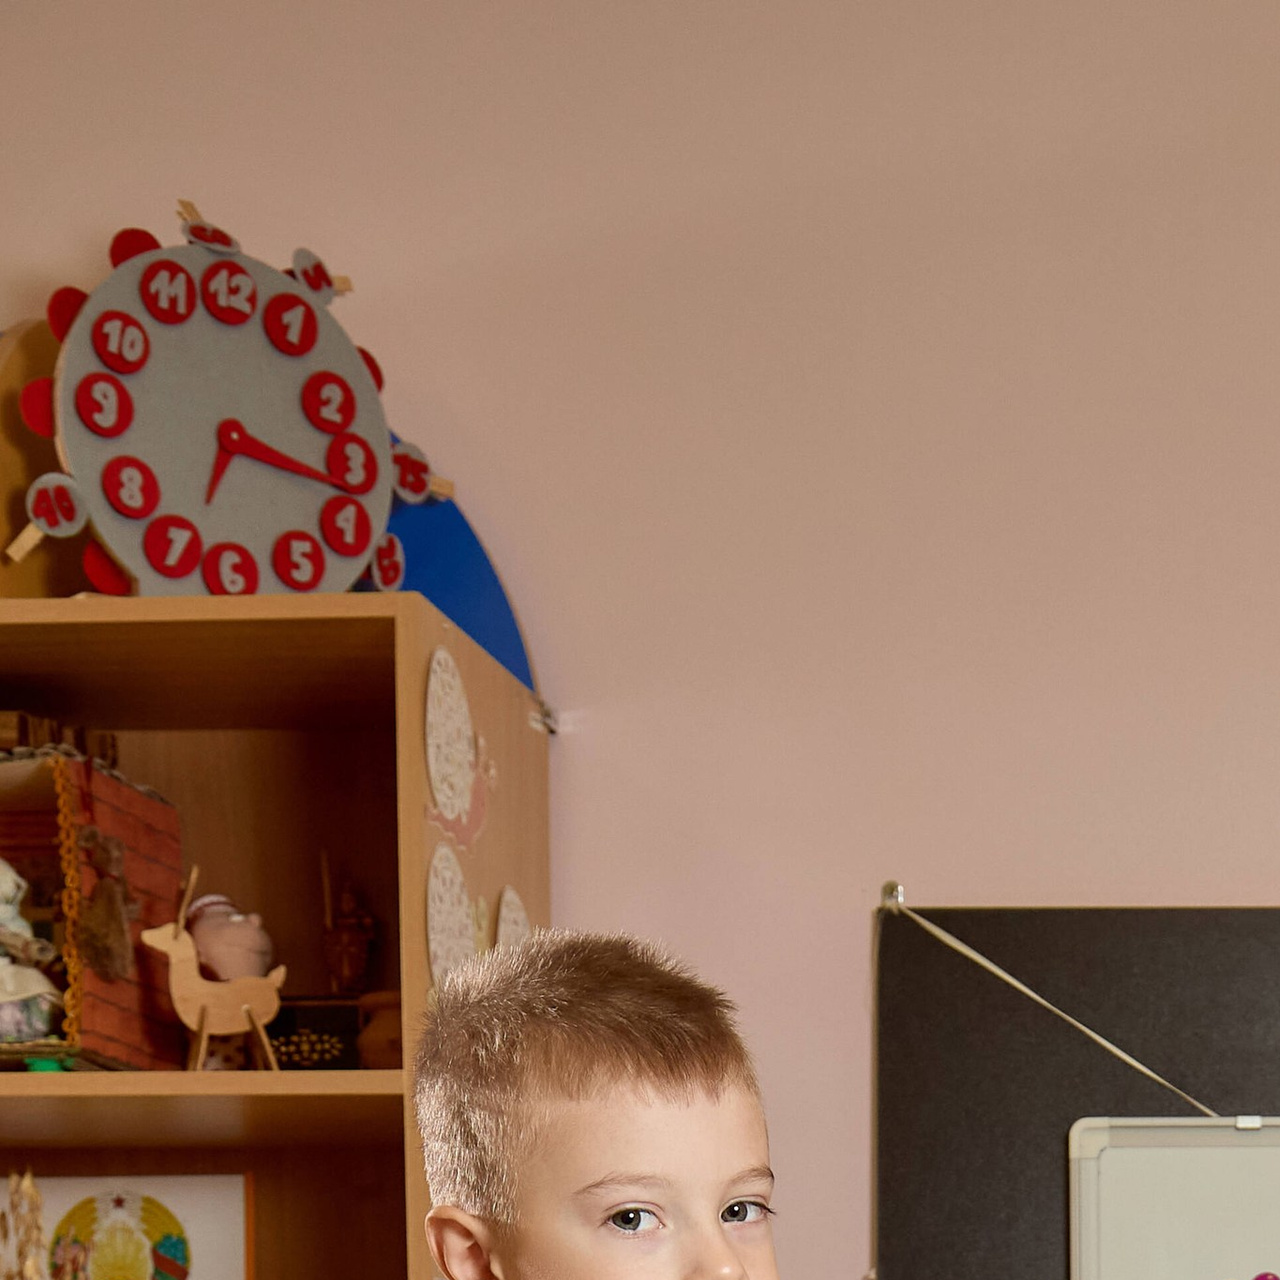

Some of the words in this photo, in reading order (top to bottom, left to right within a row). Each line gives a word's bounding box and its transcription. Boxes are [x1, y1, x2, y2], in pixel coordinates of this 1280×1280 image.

[149, 268, 187, 315] 11
[208, 268, 252, 314] 12
[102, 318, 145, 363] 10
[281, 304, 306, 345] 1
[91, 380, 120, 430] 9
[319, 382, 345, 424] 2
[343, 441, 366, 487] 3
[118, 465, 144, 510] 8
[164, 526, 193, 567] 7
[289, 538, 314, 583] 5
[217, 550, 246, 594] 6
